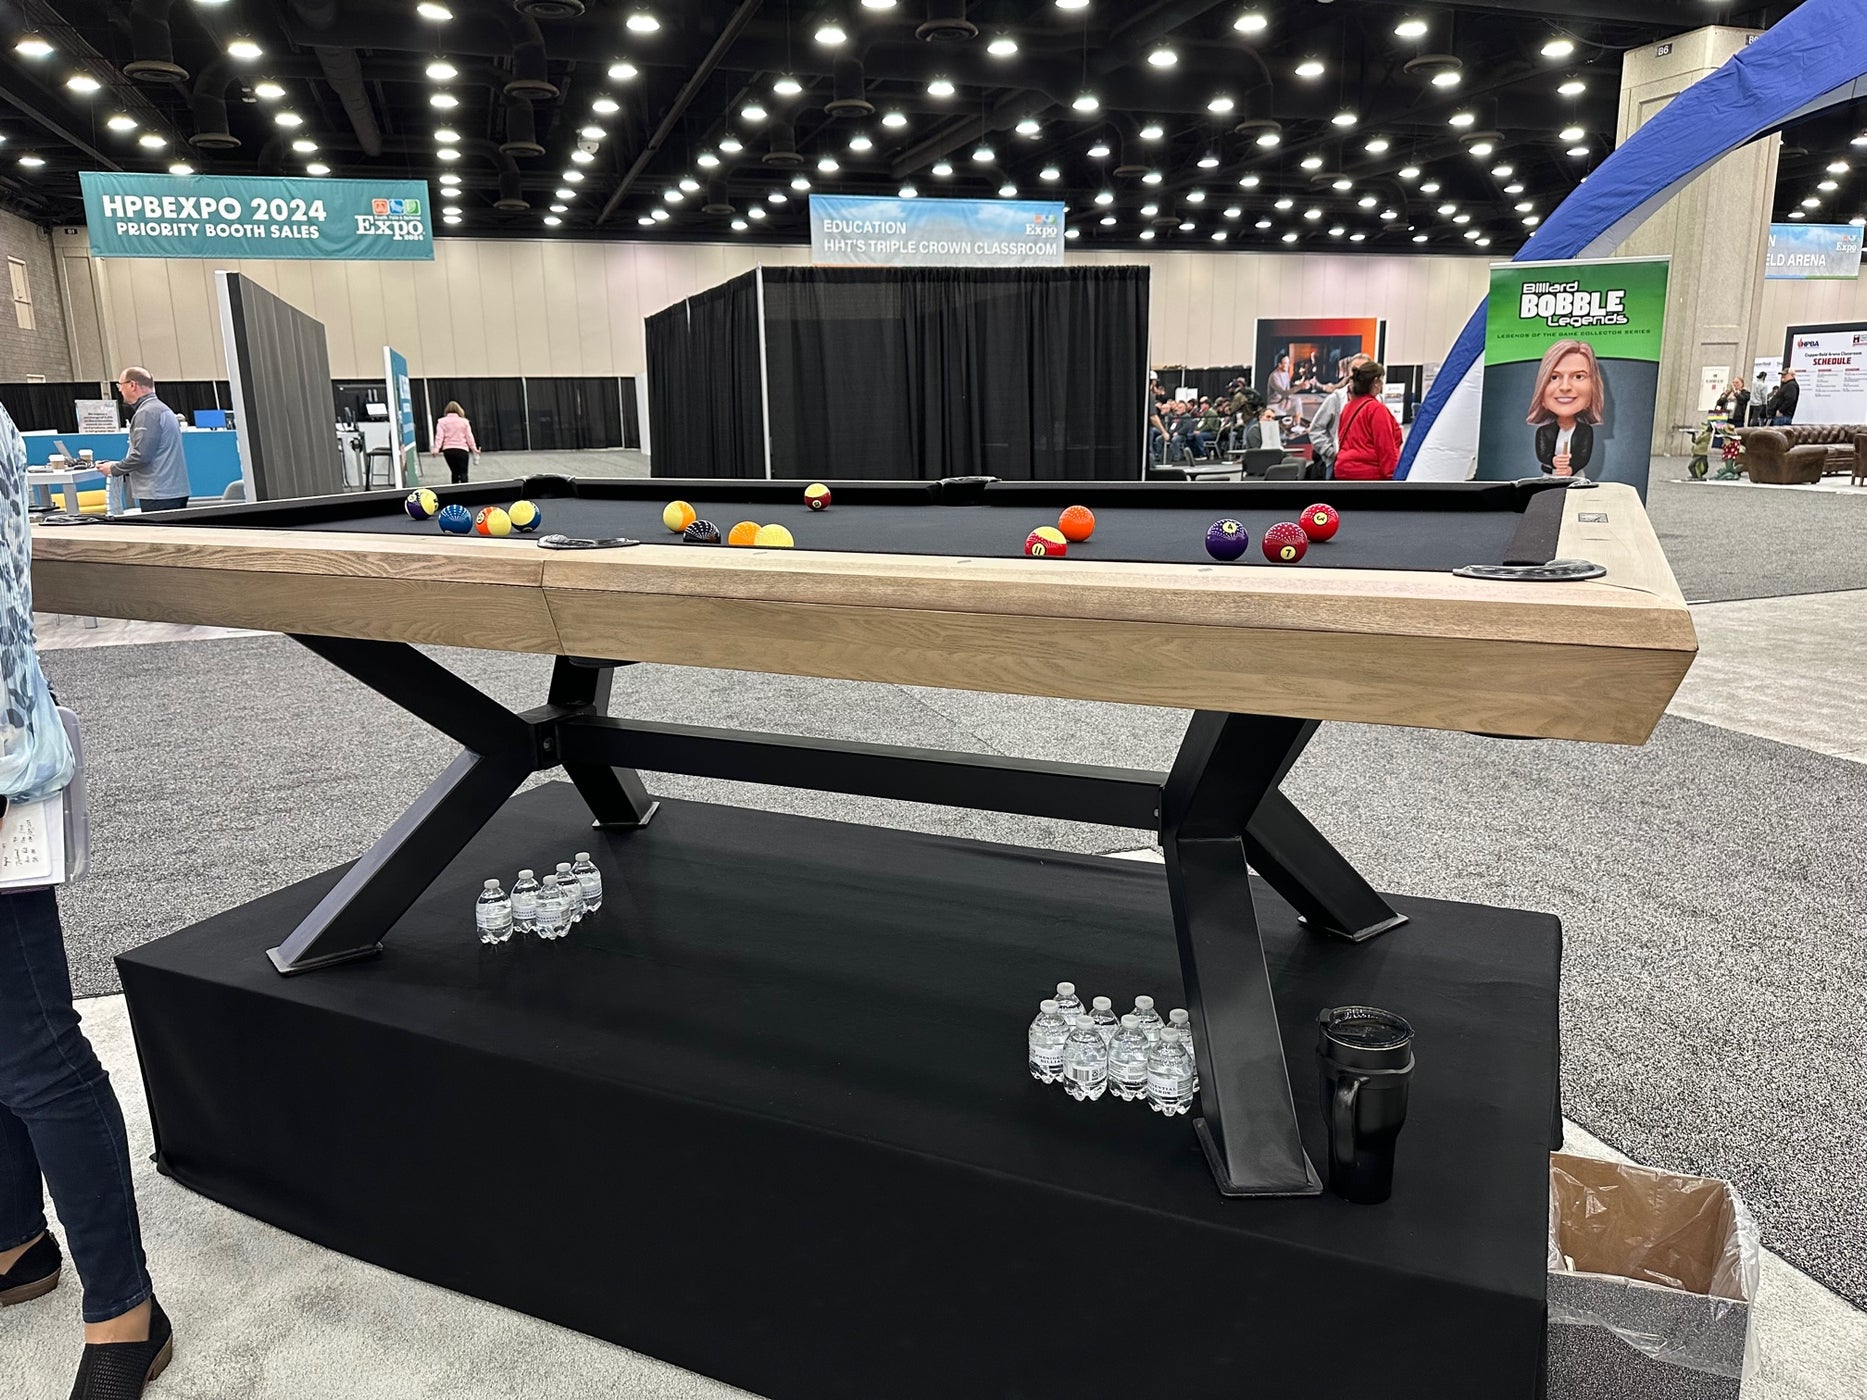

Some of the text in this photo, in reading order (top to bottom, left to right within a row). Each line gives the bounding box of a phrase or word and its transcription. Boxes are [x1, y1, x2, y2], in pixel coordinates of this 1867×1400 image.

[1658, 45, 1669, 56] B6
[102, 194, 327, 222] HPBEXPO 2024
[116, 221, 320, 239] PRIORITY BOOTH SALES
[354, 214, 424, 241] Expo
[823, 219, 907, 235] EDUCATION
[1025, 222, 1058, 239] Expo
[823, 238, 1057, 256] HHT'S TRIPLE CROWN CLASSROOM
[1786, 253, 1827, 267] ARENA
[1520, 290, 1625, 318] BOBBLE
[1547, 313, 1628, 327] Legends
[1812, 356, 1852, 366] SCHEDULE
[1285, 549, 1292, 558] 7
